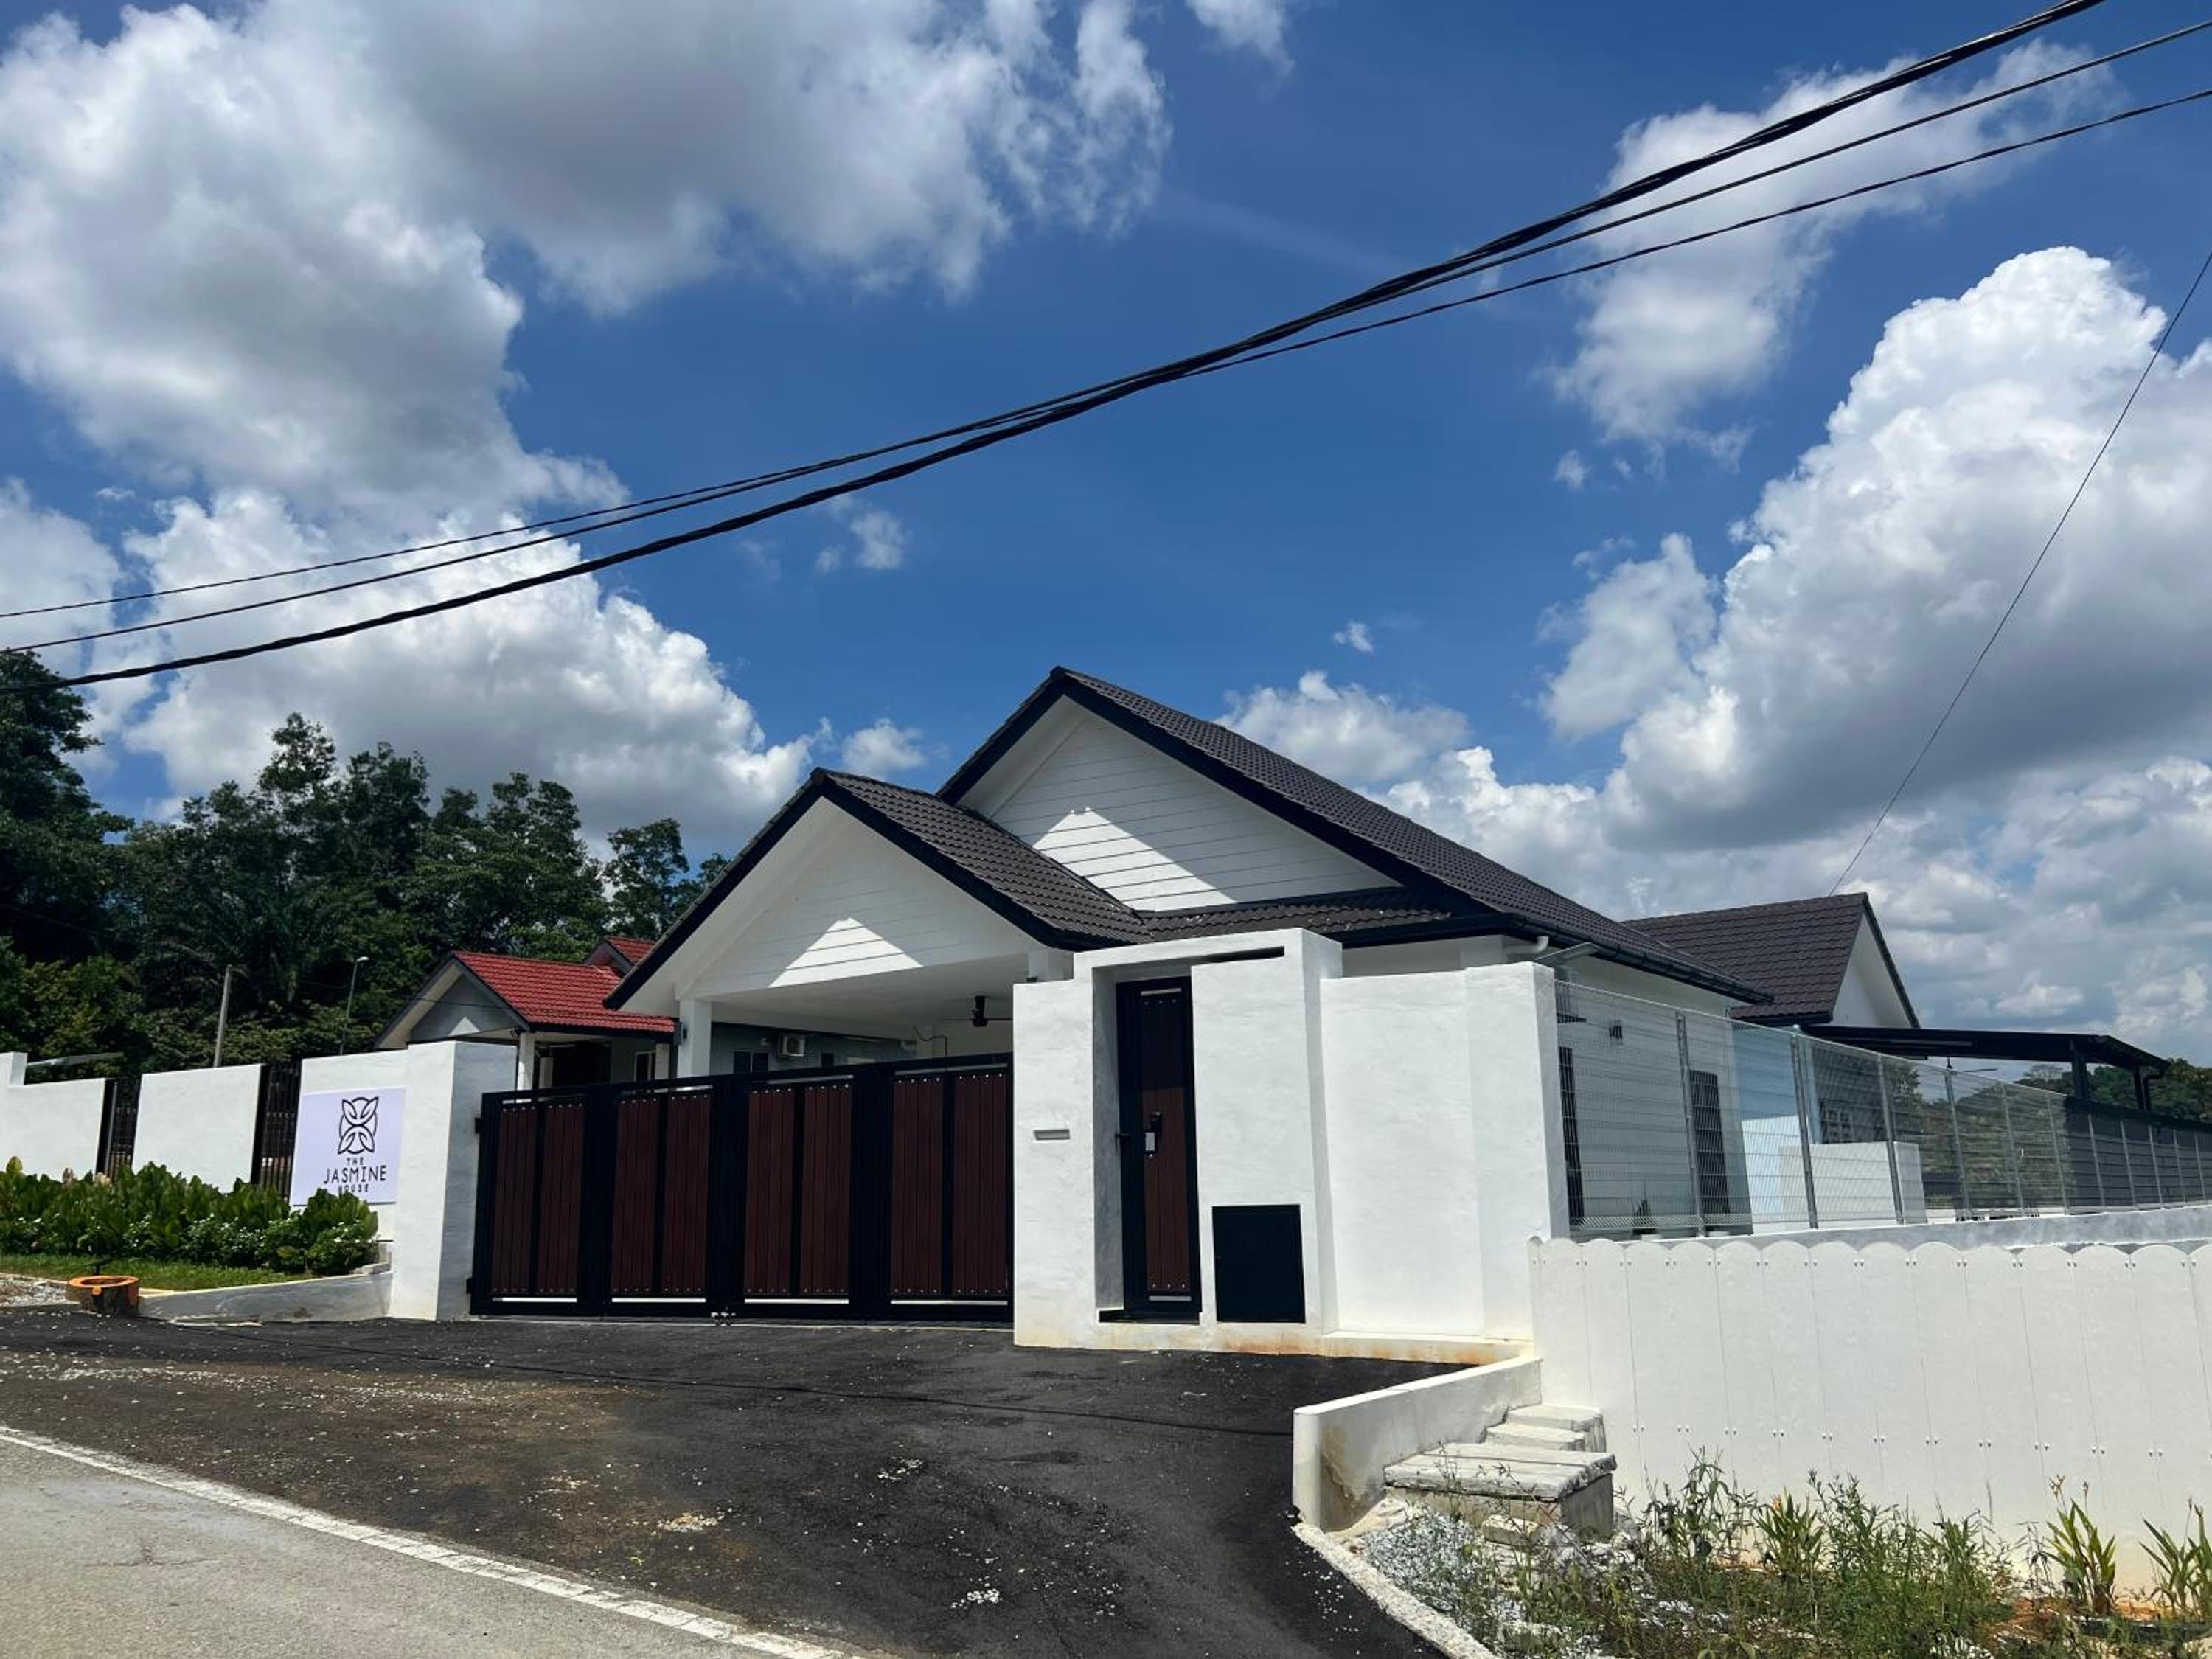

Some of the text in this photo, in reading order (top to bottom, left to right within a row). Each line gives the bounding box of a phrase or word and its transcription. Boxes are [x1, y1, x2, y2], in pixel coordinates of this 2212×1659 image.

[347, 1157, 364, 1165] THE
[324, 1165, 387, 1184] JASMINE
[338, 1183, 369, 1192] HOUSE
